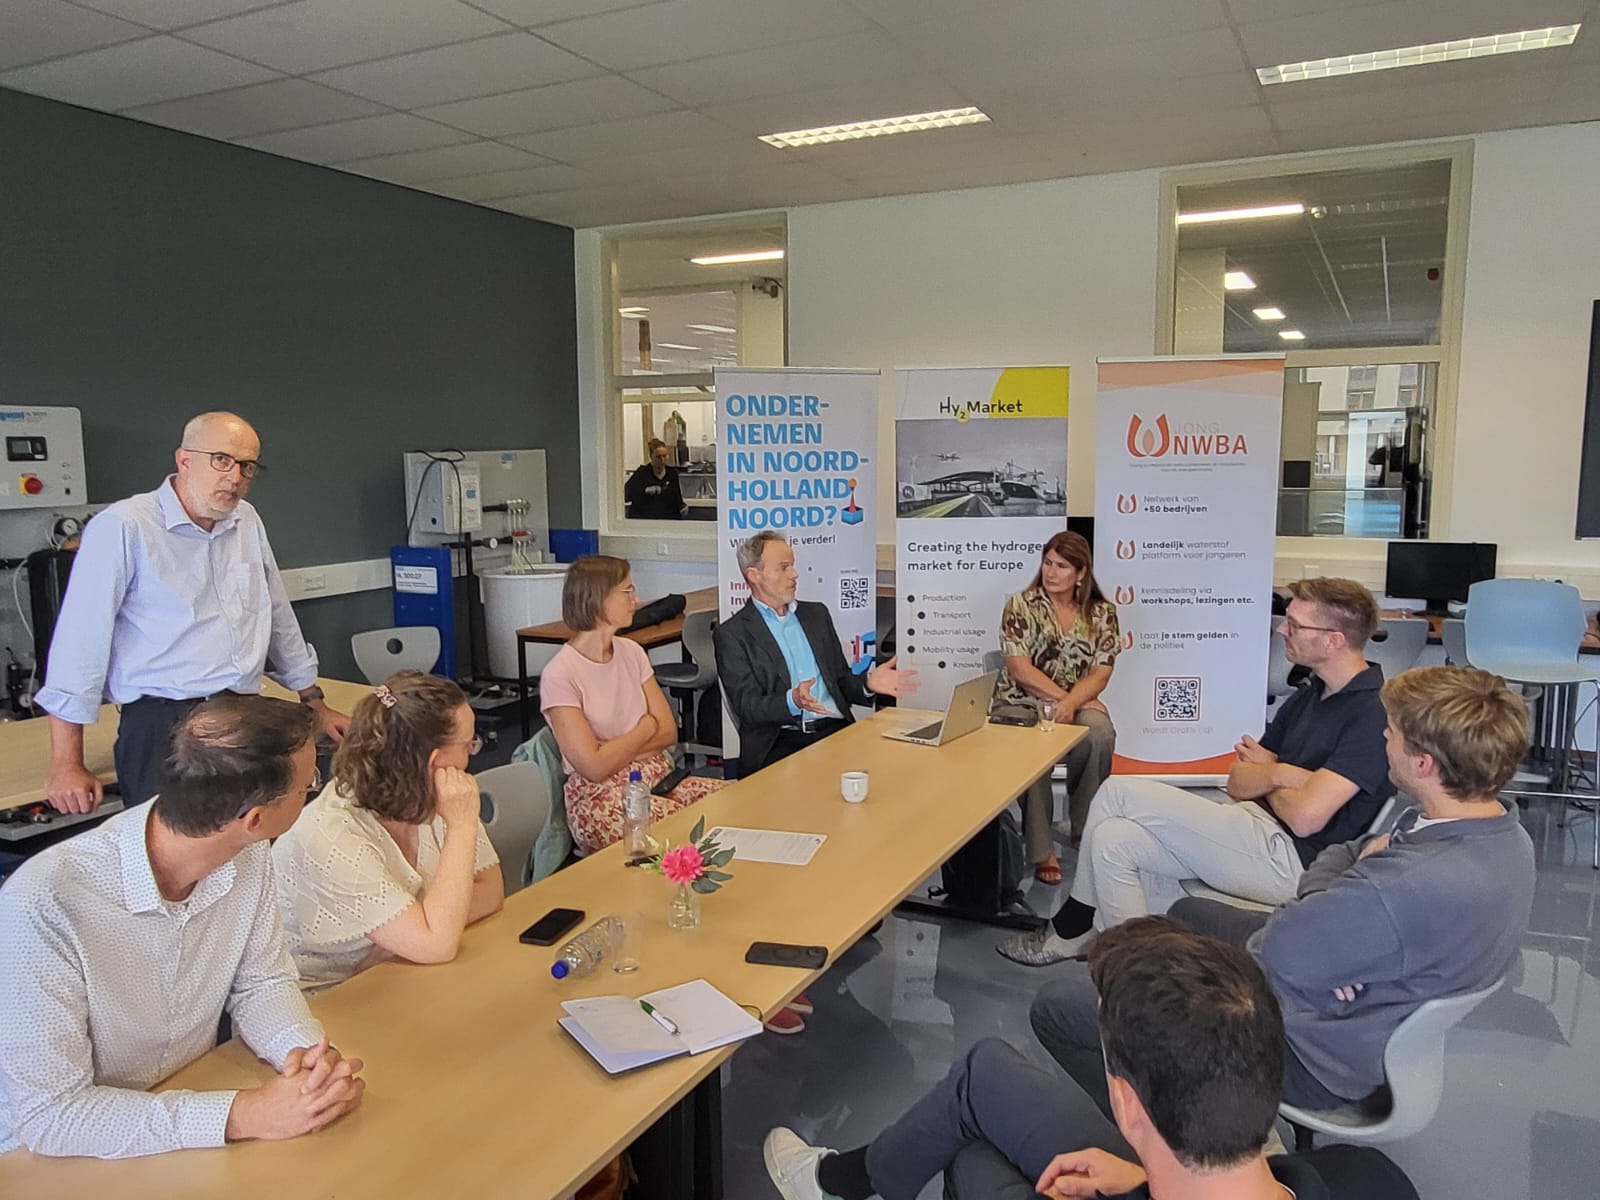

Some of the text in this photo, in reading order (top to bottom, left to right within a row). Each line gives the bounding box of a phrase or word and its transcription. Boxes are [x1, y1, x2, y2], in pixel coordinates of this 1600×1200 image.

[725, 395, 829, 416] ONDER-
[1175, 422, 1220, 434] JONG
[727, 424, 822, 445] NEMEN
[1173, 434, 1248, 455] NWBA
[727, 451, 869, 473] IN NOORD-
[728, 478, 851, 502] HOLLAND
[1144, 504, 1208, 514] +50 bedrijven
[728, 505, 837, 530] NOORD?
[789, 534, 836, 548] je verder!
[1142, 541, 1230, 550] Landelijk waterstof
[907, 542, 962, 554] Creating
[966, 541, 988, 552] the
[1142, 552, 1181, 560] platform
[1205, 551, 1246, 560] jongeren
[907, 560, 1024, 572] market for Europe
[1140, 596, 1254, 606] workshops, lezingen etc.
[933, 612, 972, 620] Transport
[1161, 631, 1170, 640] je
[1197, 632, 1228, 640] gelden
[1140, 641, 1152, 649] de
